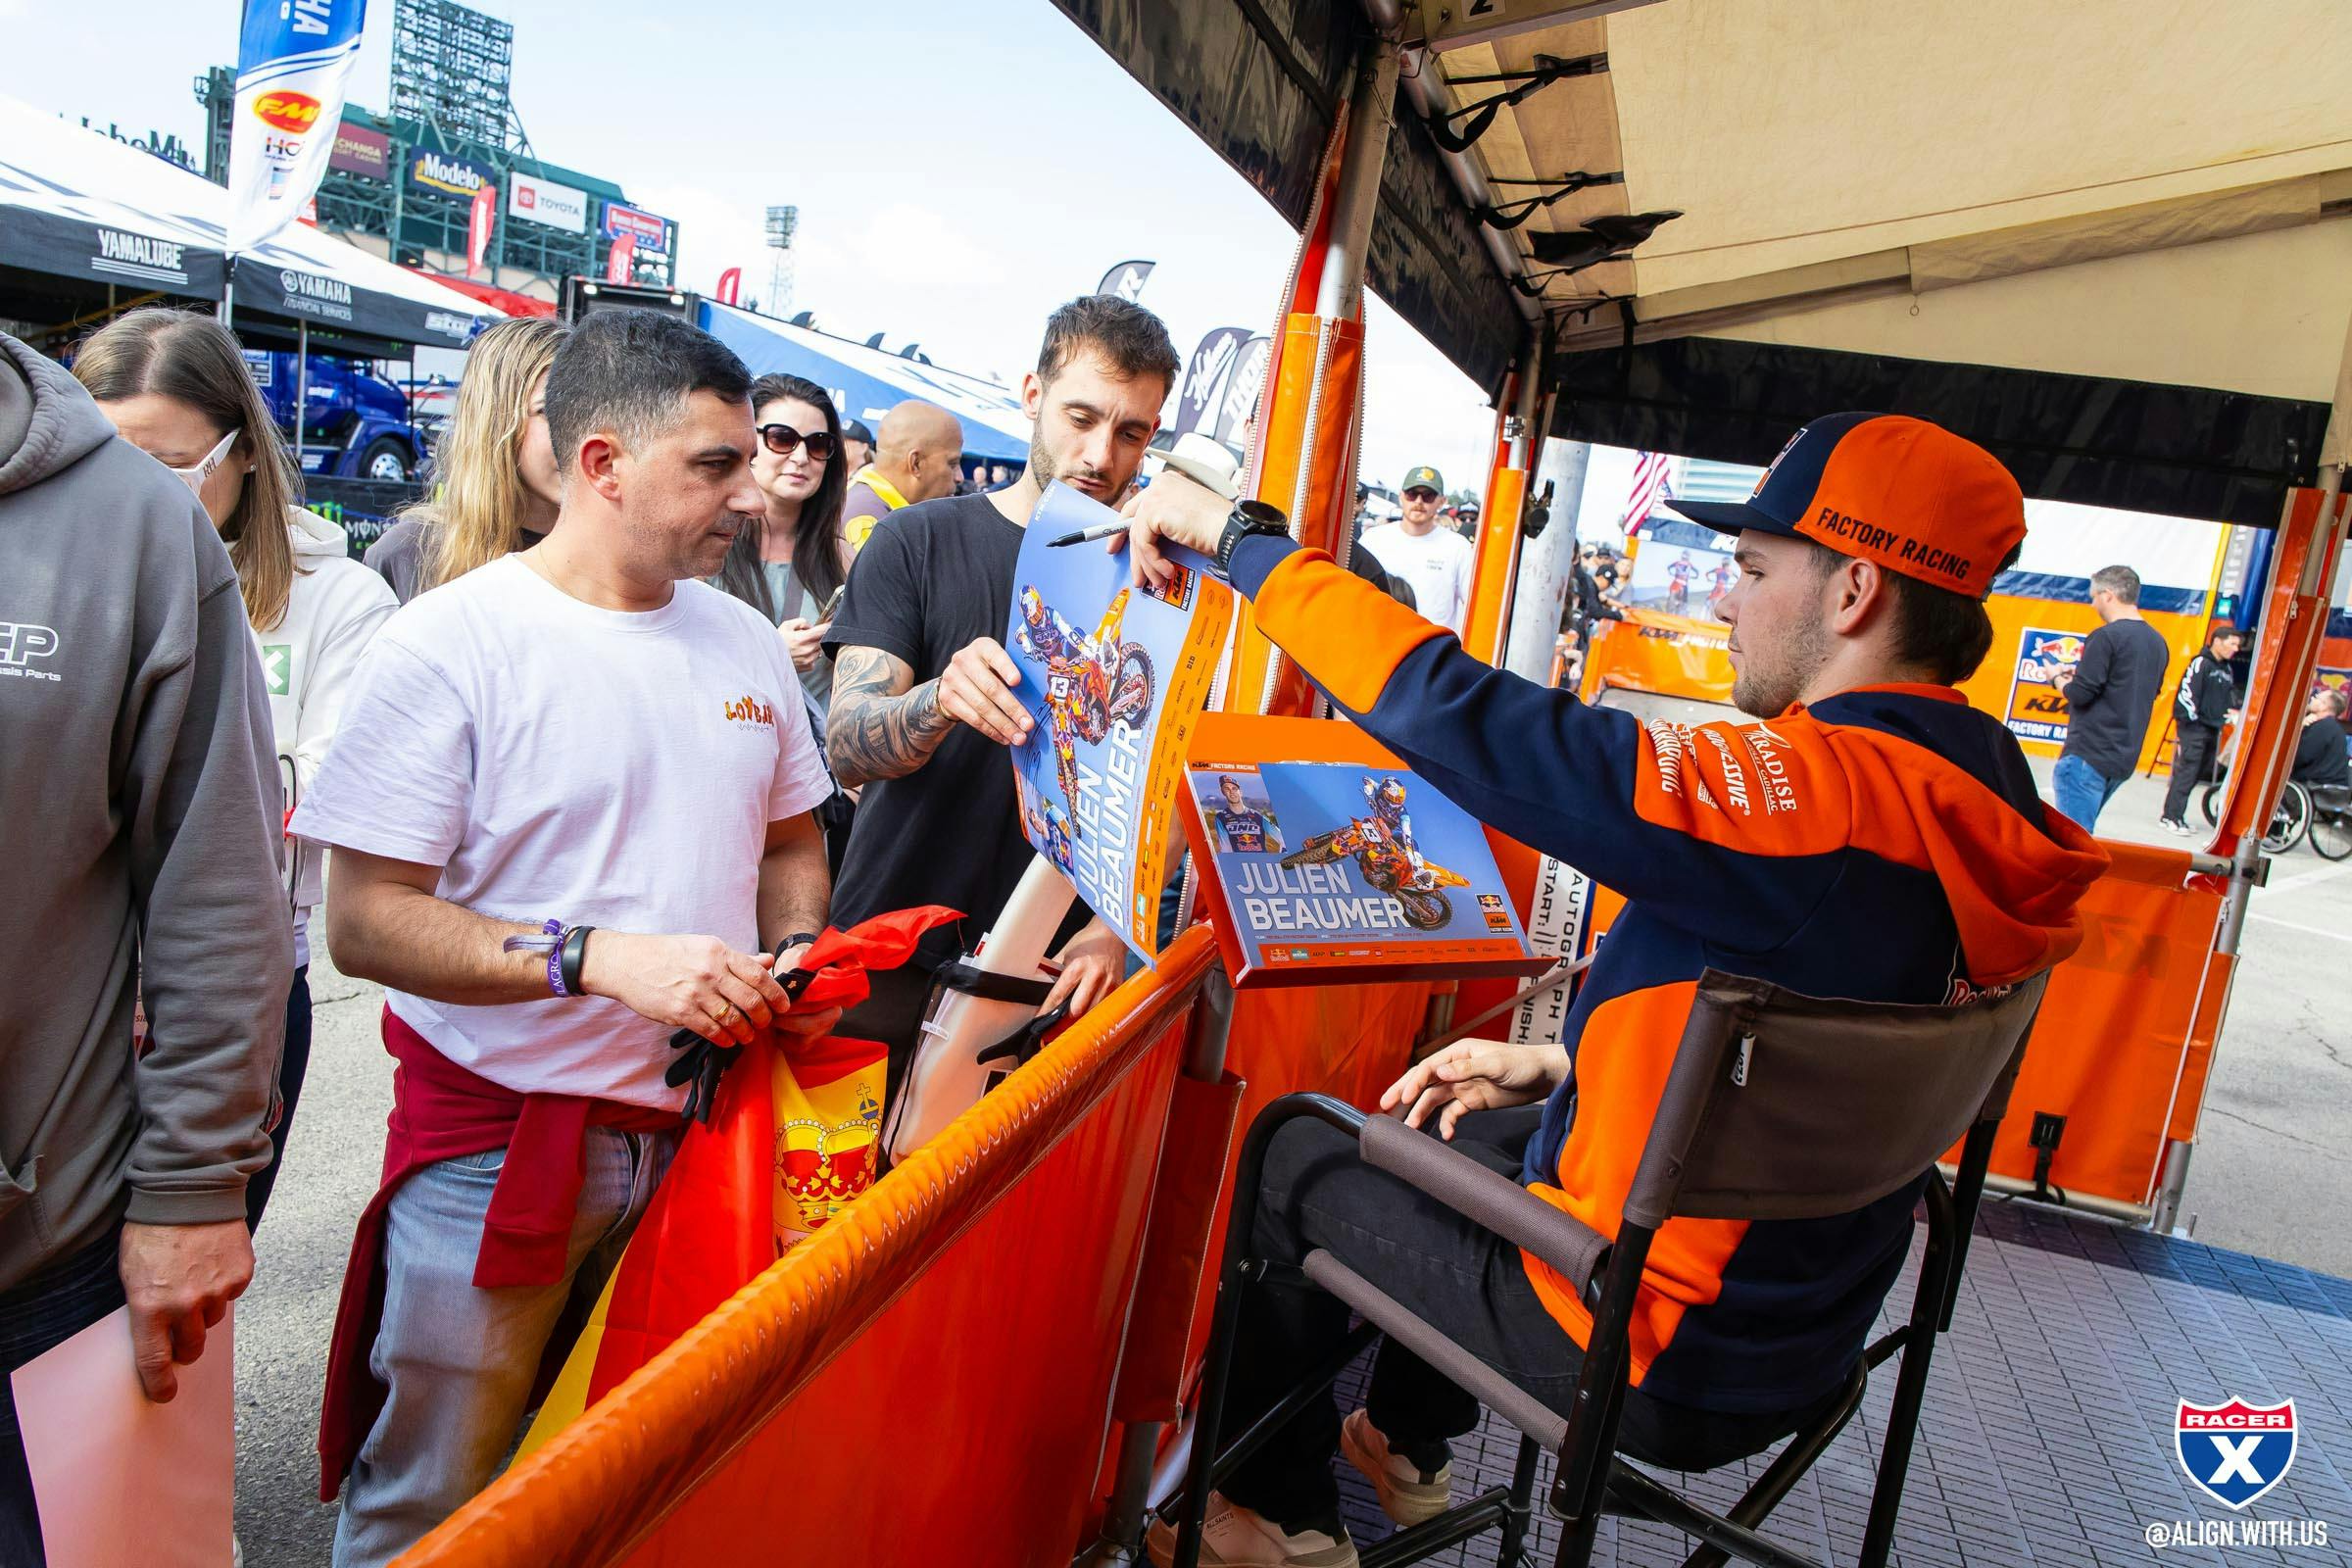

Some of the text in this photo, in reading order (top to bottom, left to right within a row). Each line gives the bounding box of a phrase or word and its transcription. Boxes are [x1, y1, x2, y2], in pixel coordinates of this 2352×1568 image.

[423, 152, 479, 190] Modelo
[540, 197, 580, 217] TOYOTA
[97, 228, 183, 270] YAMALUBE
[296, 273, 352, 306] YAMAHA
[321, 304, 353, 321] SERVICES
[1816, 507, 1970, 580] FACTORY RACING
[25, 668, 62, 682] Parts
[1051, 676, 1070, 699] 13
[2007, 718, 2052, 738] FACTORY
[1080, 764, 1104, 906] JULIEN
[1102, 718, 1145, 929] BEAUMER
[1236, 862, 1351, 895] JULIEN
[1538, 858, 1559, 926] START:
[1244, 897, 1412, 931] BEAUMER
